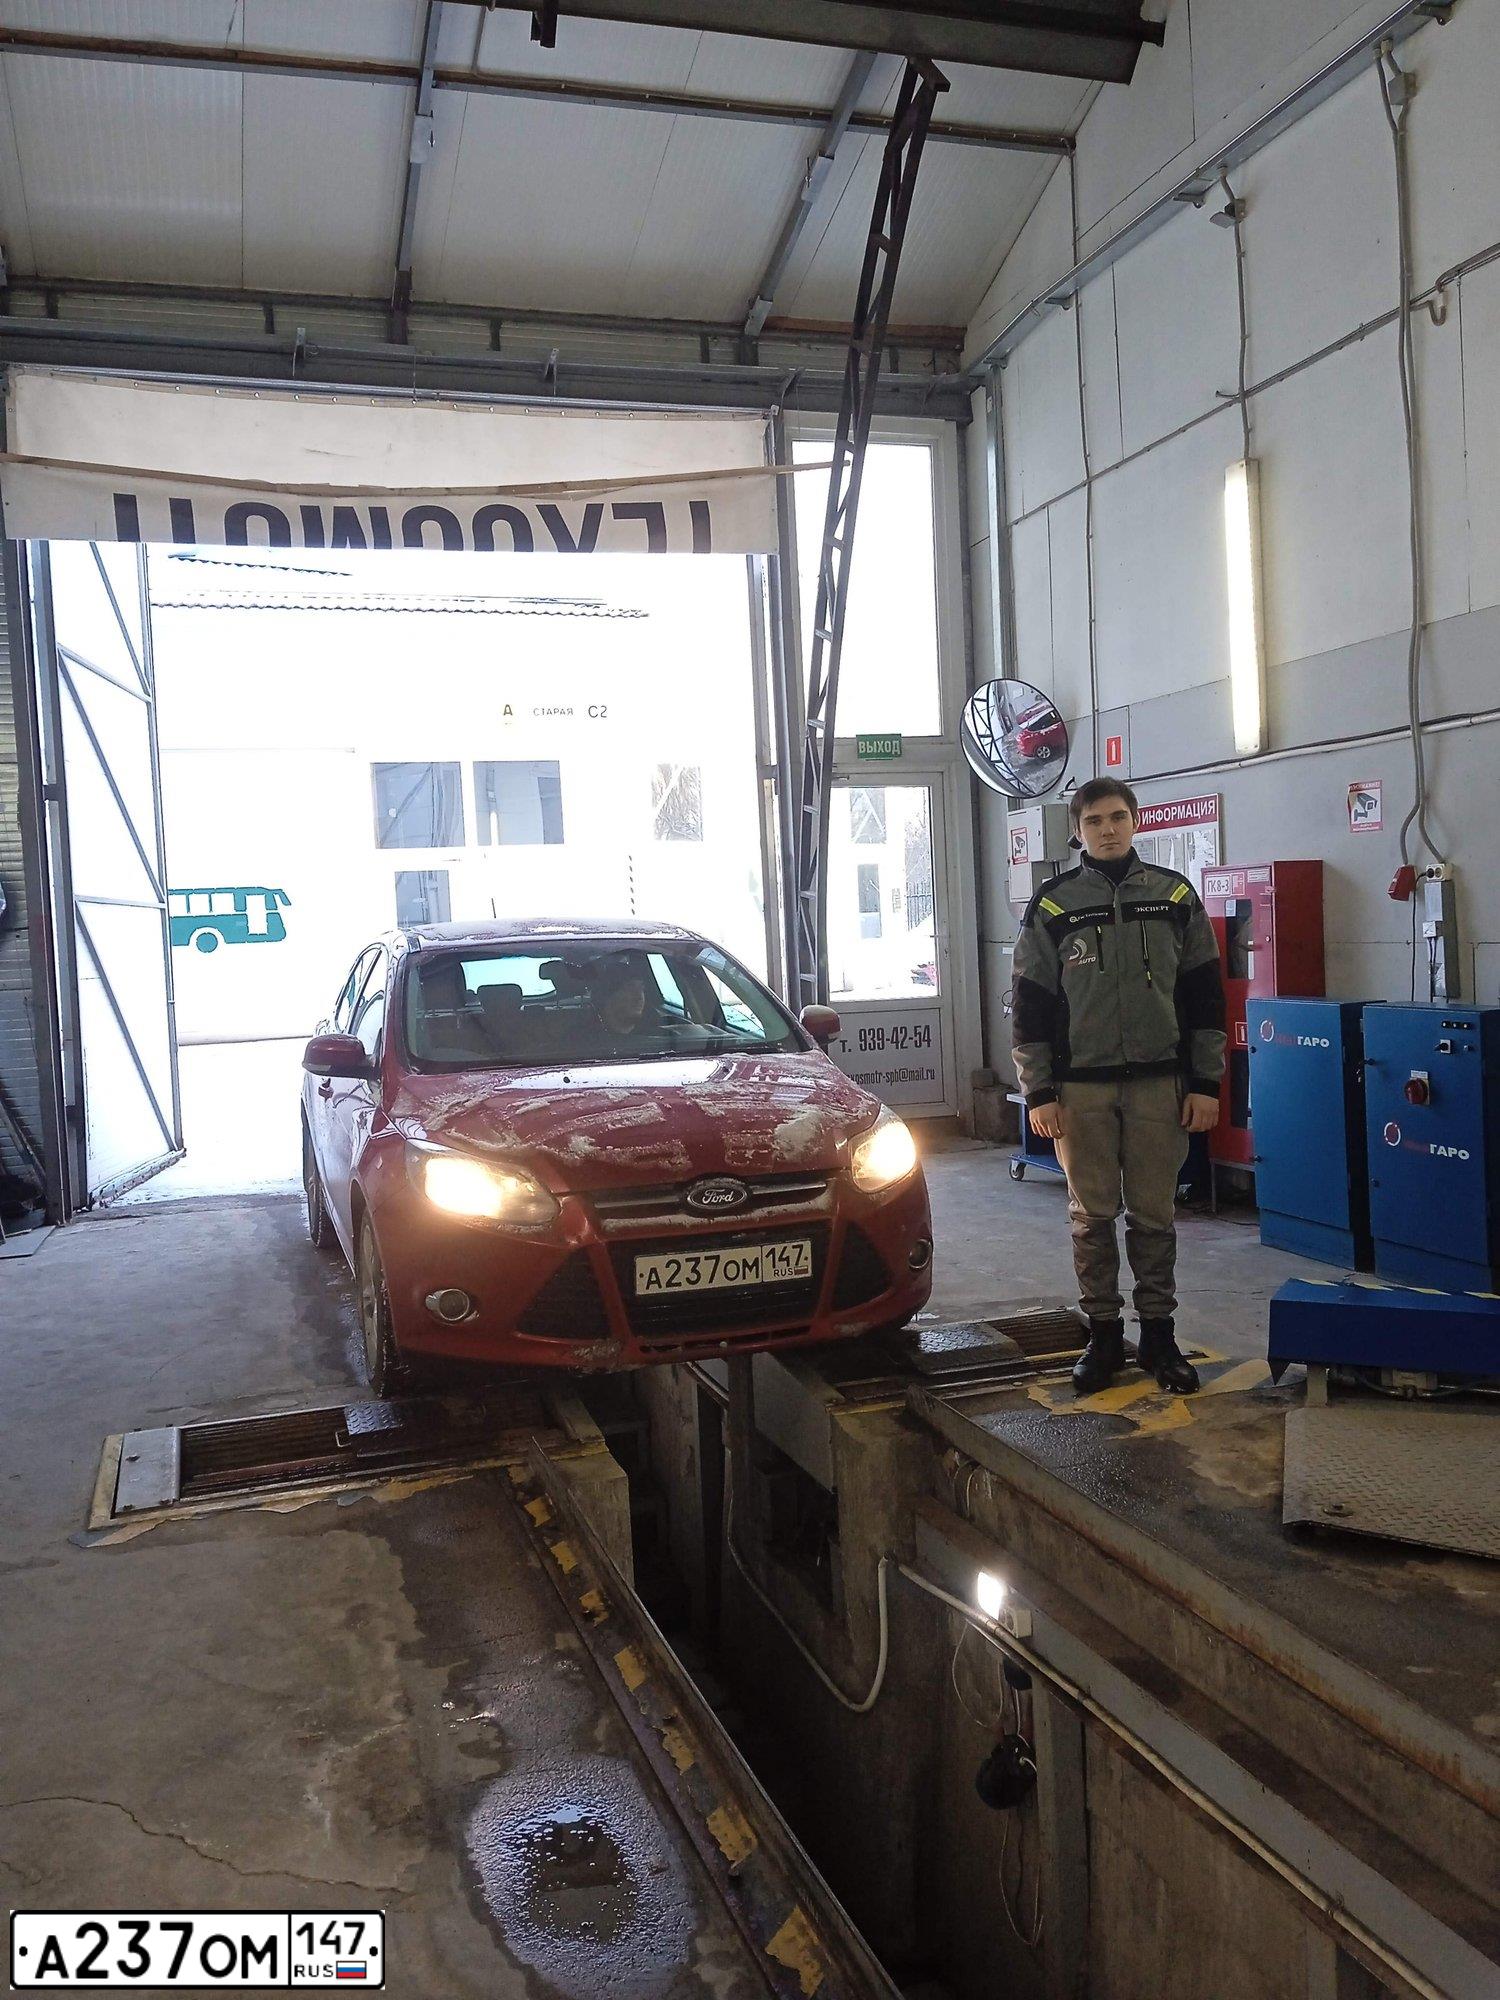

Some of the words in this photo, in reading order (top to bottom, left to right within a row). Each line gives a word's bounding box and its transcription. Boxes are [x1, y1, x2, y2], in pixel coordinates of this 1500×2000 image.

[858, 741, 900, 755] ВЫХОД
[1141, 799, 1216, 826] ИНФОРМАЦИЯ
[859, 1025, 932, 1052] 939-42-54
[702, 1189, 734, 1204] Ford
[765, 1244, 804, 1269] 147
[773, 1267, 794, 1278] RUS
